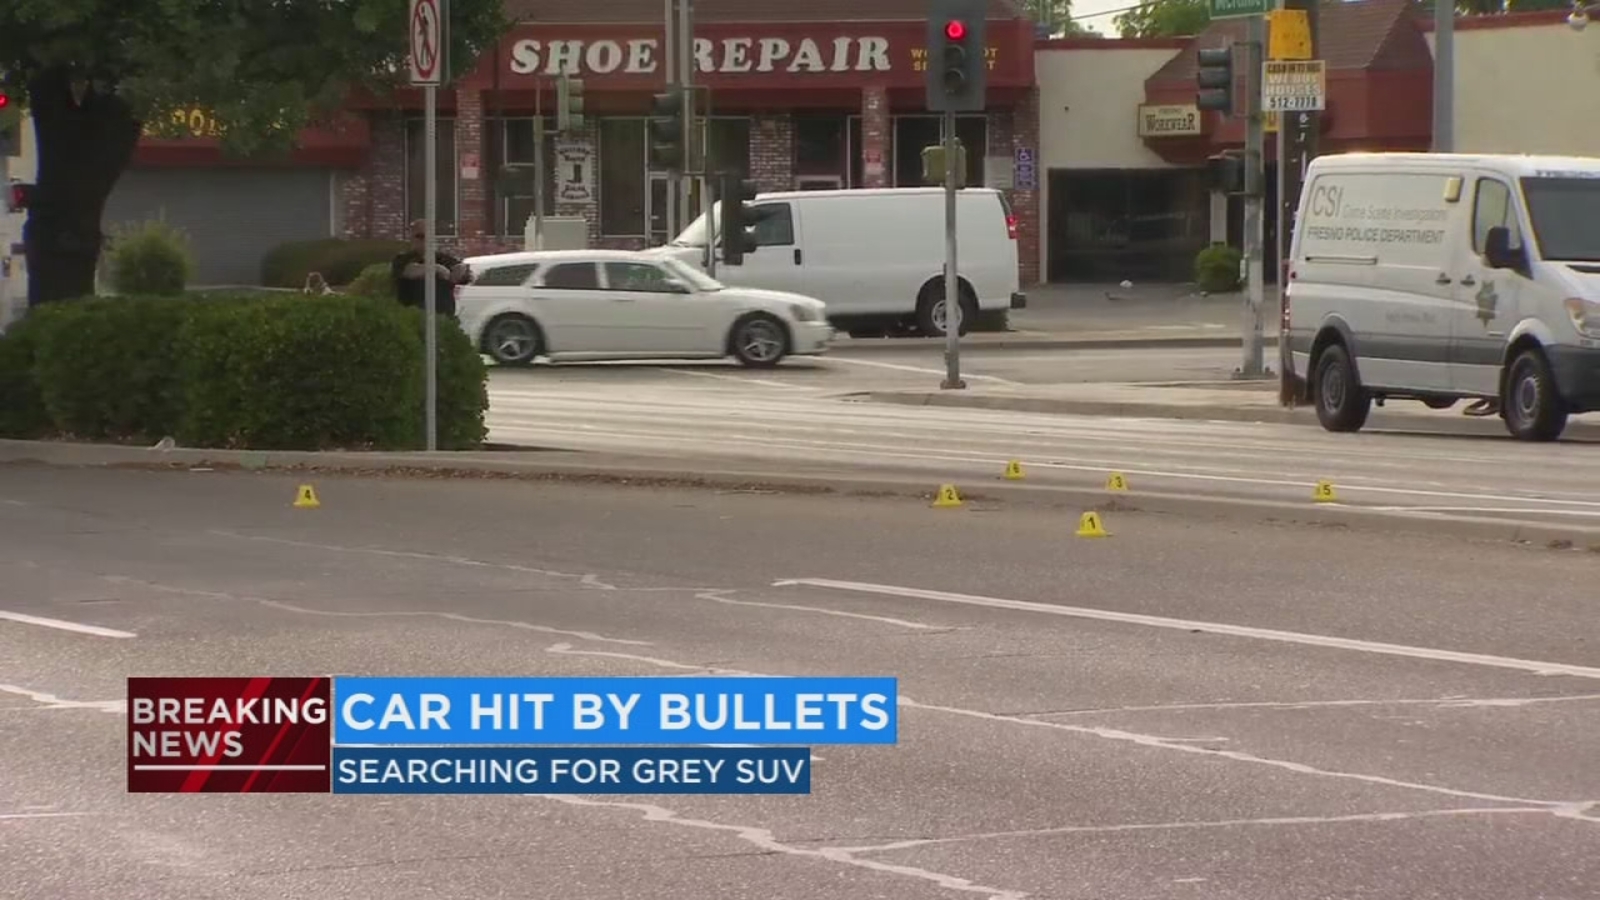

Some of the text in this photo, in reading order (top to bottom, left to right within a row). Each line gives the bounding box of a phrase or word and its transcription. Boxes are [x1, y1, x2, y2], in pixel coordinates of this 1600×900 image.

[509, 36, 891, 74] SHOE REPAIR
[1313, 185, 1343, 217] CSI
[1308, 226, 1446, 244] FRESNO POLICE DEPARTMENT
[1115, 476, 1122, 487] 3
[304, 489, 312, 499] 4
[945, 489, 953, 500] 2
[1322, 484, 1331, 495] 5
